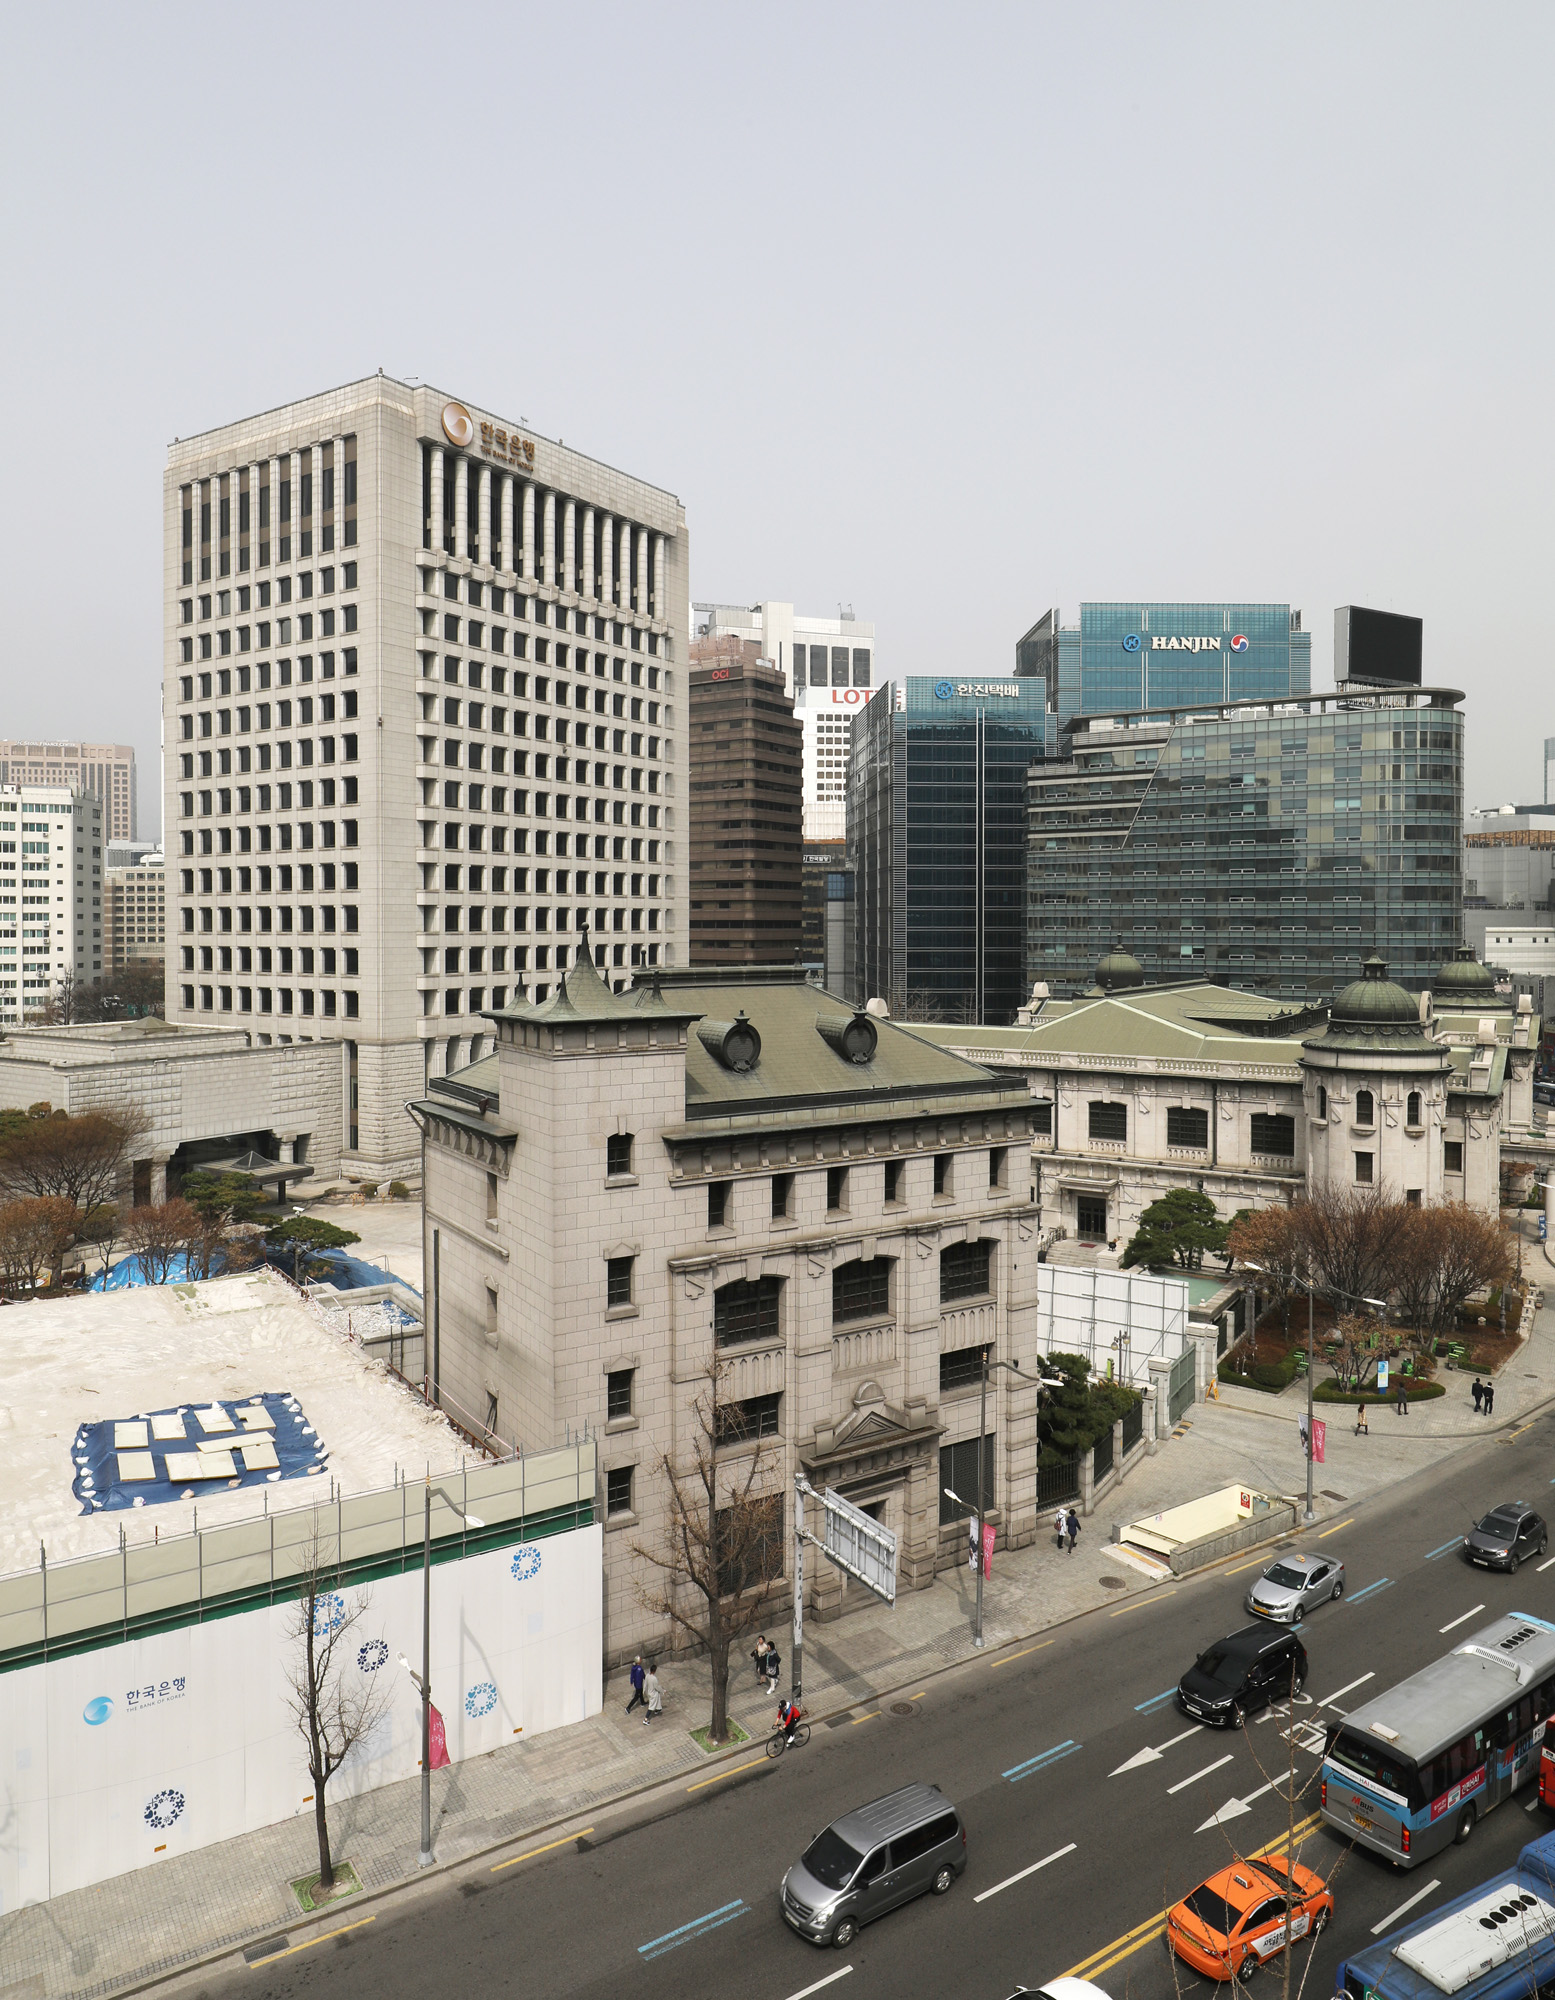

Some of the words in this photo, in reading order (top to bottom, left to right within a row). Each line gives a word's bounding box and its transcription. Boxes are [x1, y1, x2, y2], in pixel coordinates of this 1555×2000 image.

[480, 422, 534, 462] 한국은행
[480, 444, 491, 455] THE
[493, 450, 507, 461] BANK
[517, 460, 534, 471] KOREA
[1151, 636, 1221, 654] HANJIN
[957, 684, 1019, 697] 한진택배
[126, 1676, 186, 1705] 한국은행
[139, 1701, 155, 1709] BANK
[166, 1693, 186, 1702] KOREA
